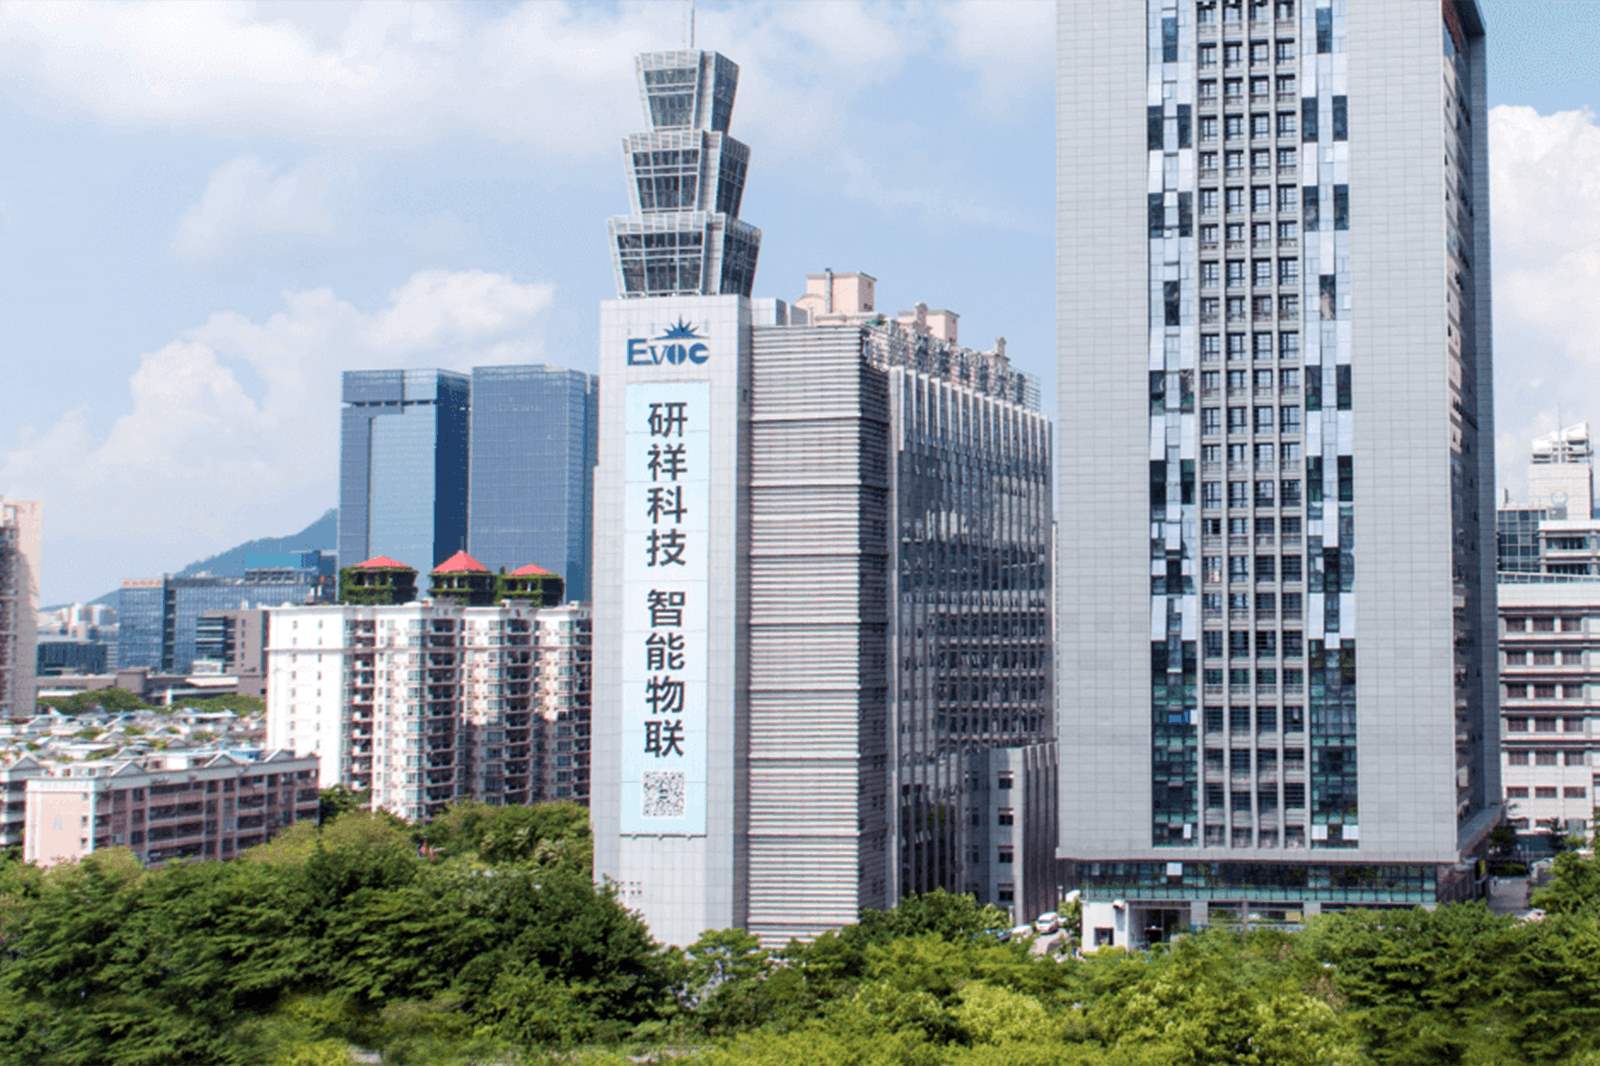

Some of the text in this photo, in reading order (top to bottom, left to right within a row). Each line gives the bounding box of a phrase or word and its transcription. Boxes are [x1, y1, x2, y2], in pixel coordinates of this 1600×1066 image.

[644, 402, 688, 758] 研祥科技 智能物联
